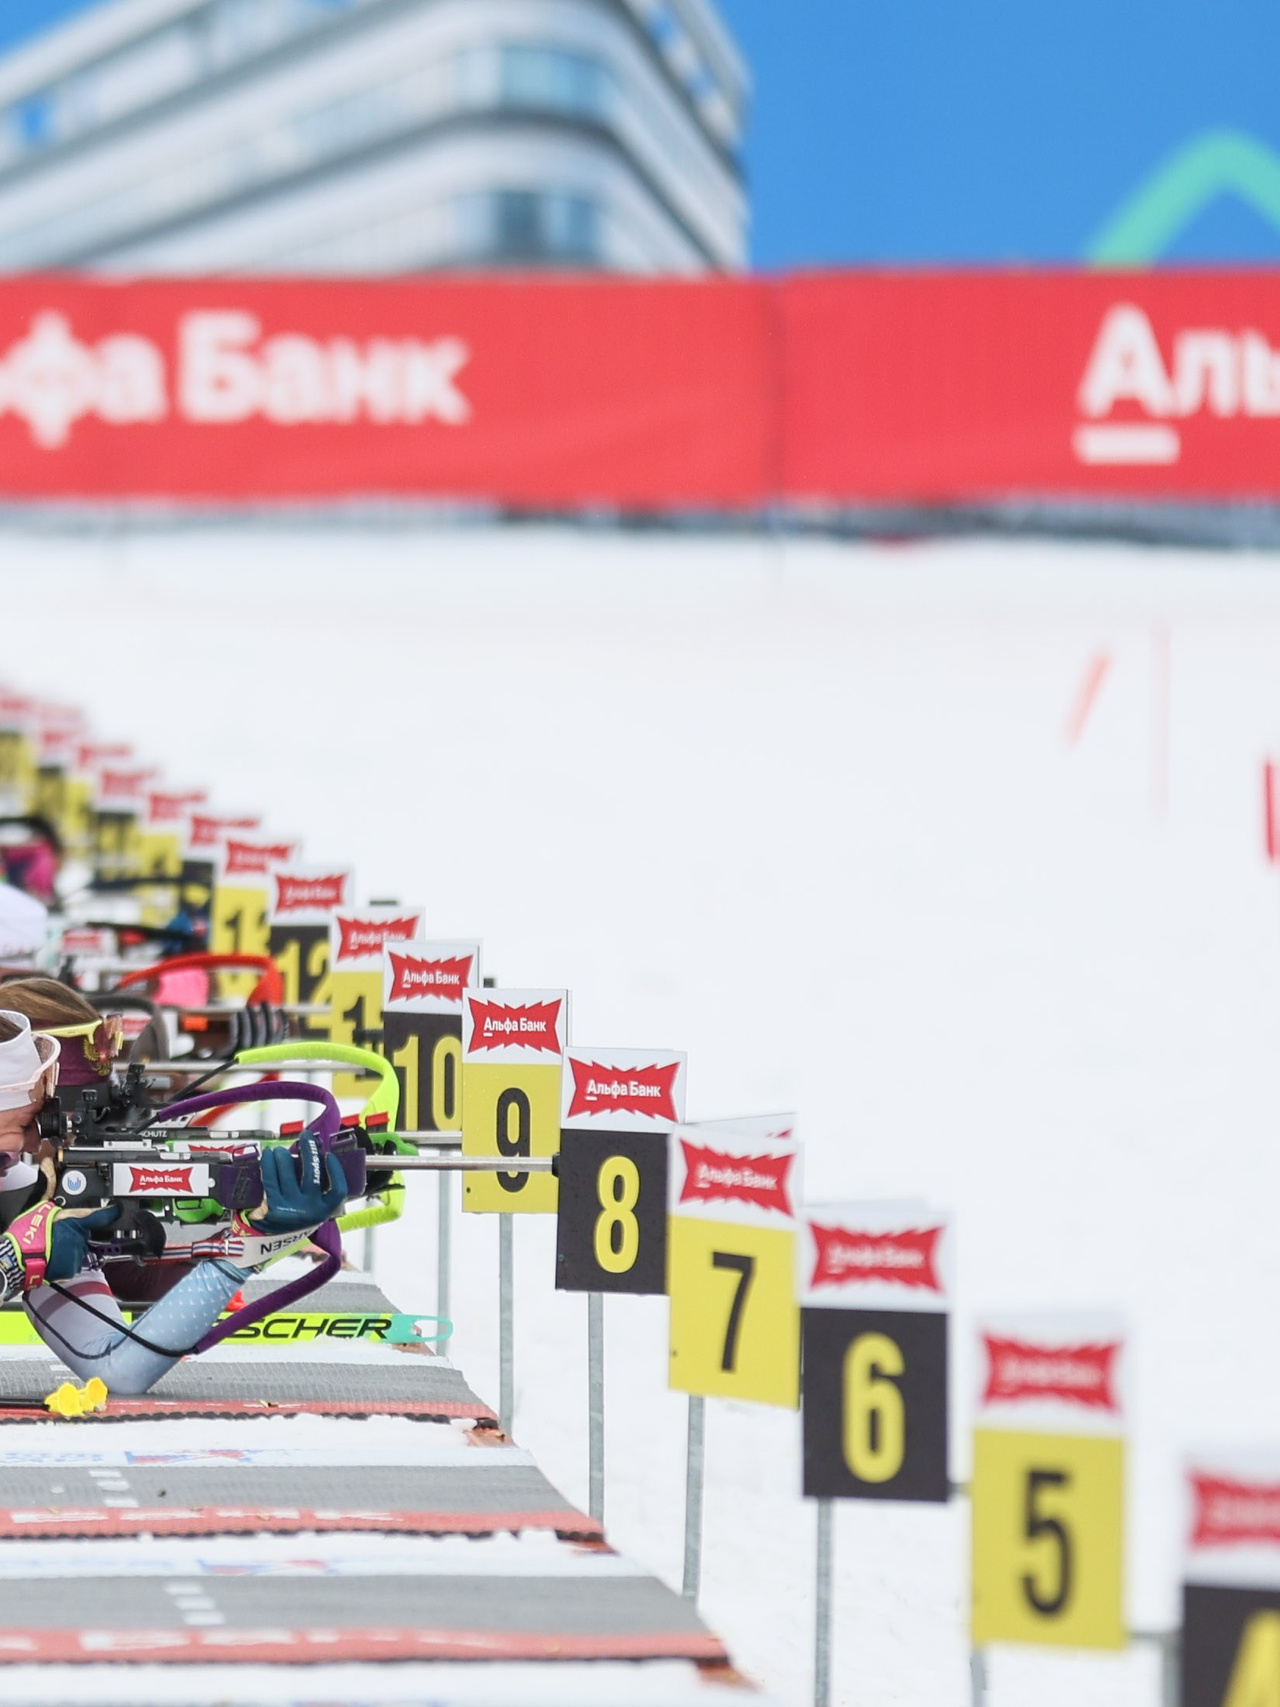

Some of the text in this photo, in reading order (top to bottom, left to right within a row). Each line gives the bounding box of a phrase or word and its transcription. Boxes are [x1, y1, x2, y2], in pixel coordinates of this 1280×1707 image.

[178, 308, 473, 426] Банк
[402, 969, 460, 988] Альфа Банк
[483, 1016, 547, 1037] Альфа Банк
[393, 1034, 462, 1132] 10
[585, 1079, 661, 1101] Альфа Банк
[496, 1087, 531, 1193] 9
[139, 1175, 183, 1186] Альфа Банк
[695, 1161, 778, 1191] Альфа Банк
[23, 1203, 52, 1245] LEKI
[594, 1155, 641, 1274] 8
[260, 1230, 312, 1255] ARSEN
[217, 1318, 393, 1340] SCHER
[711, 1250, 756, 1374] 7
[842, 1331, 906, 1484] 6
[1022, 1463, 1072, 1622] 5
